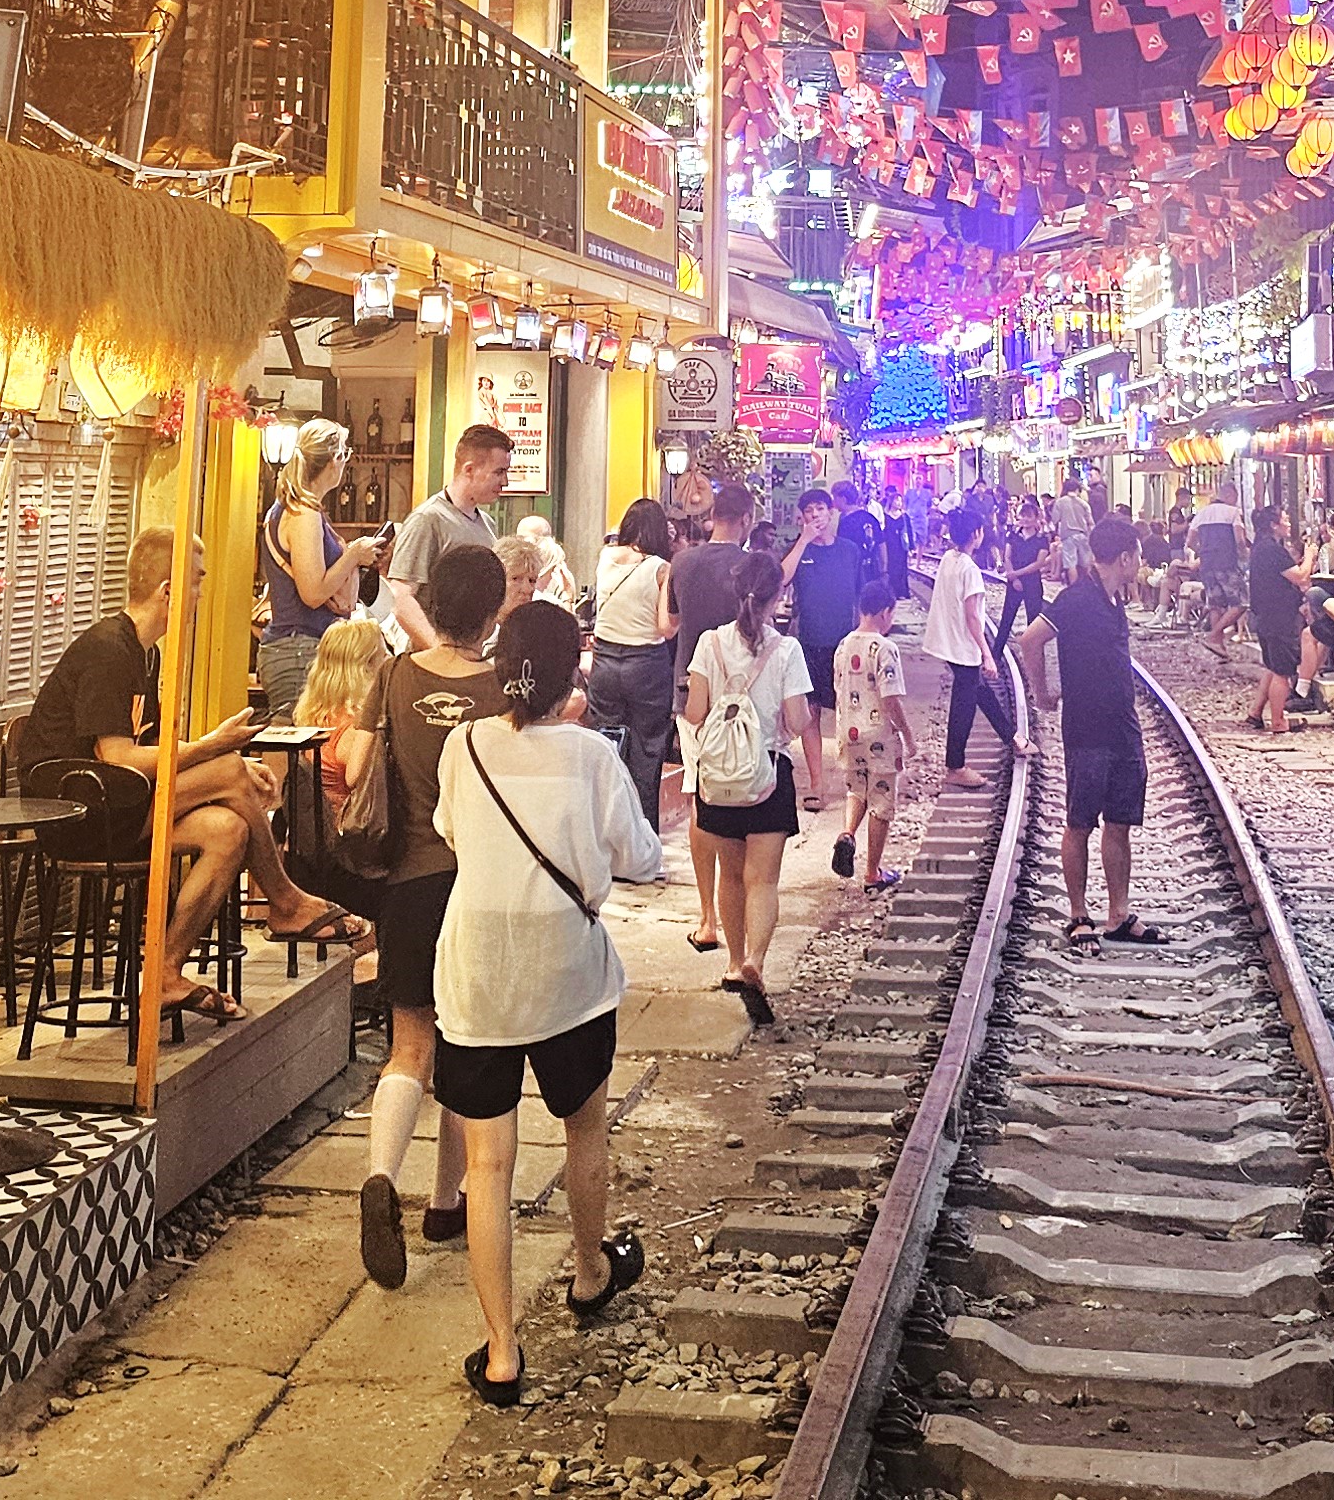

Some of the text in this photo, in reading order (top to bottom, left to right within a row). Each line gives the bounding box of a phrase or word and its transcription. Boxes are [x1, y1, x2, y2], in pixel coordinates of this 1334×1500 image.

[503, 403, 542, 413] COME BACK
[741, 400, 787, 413] RAILWAY
[519, 417, 527, 426] TO
[511, 448, 542, 456] STORY
